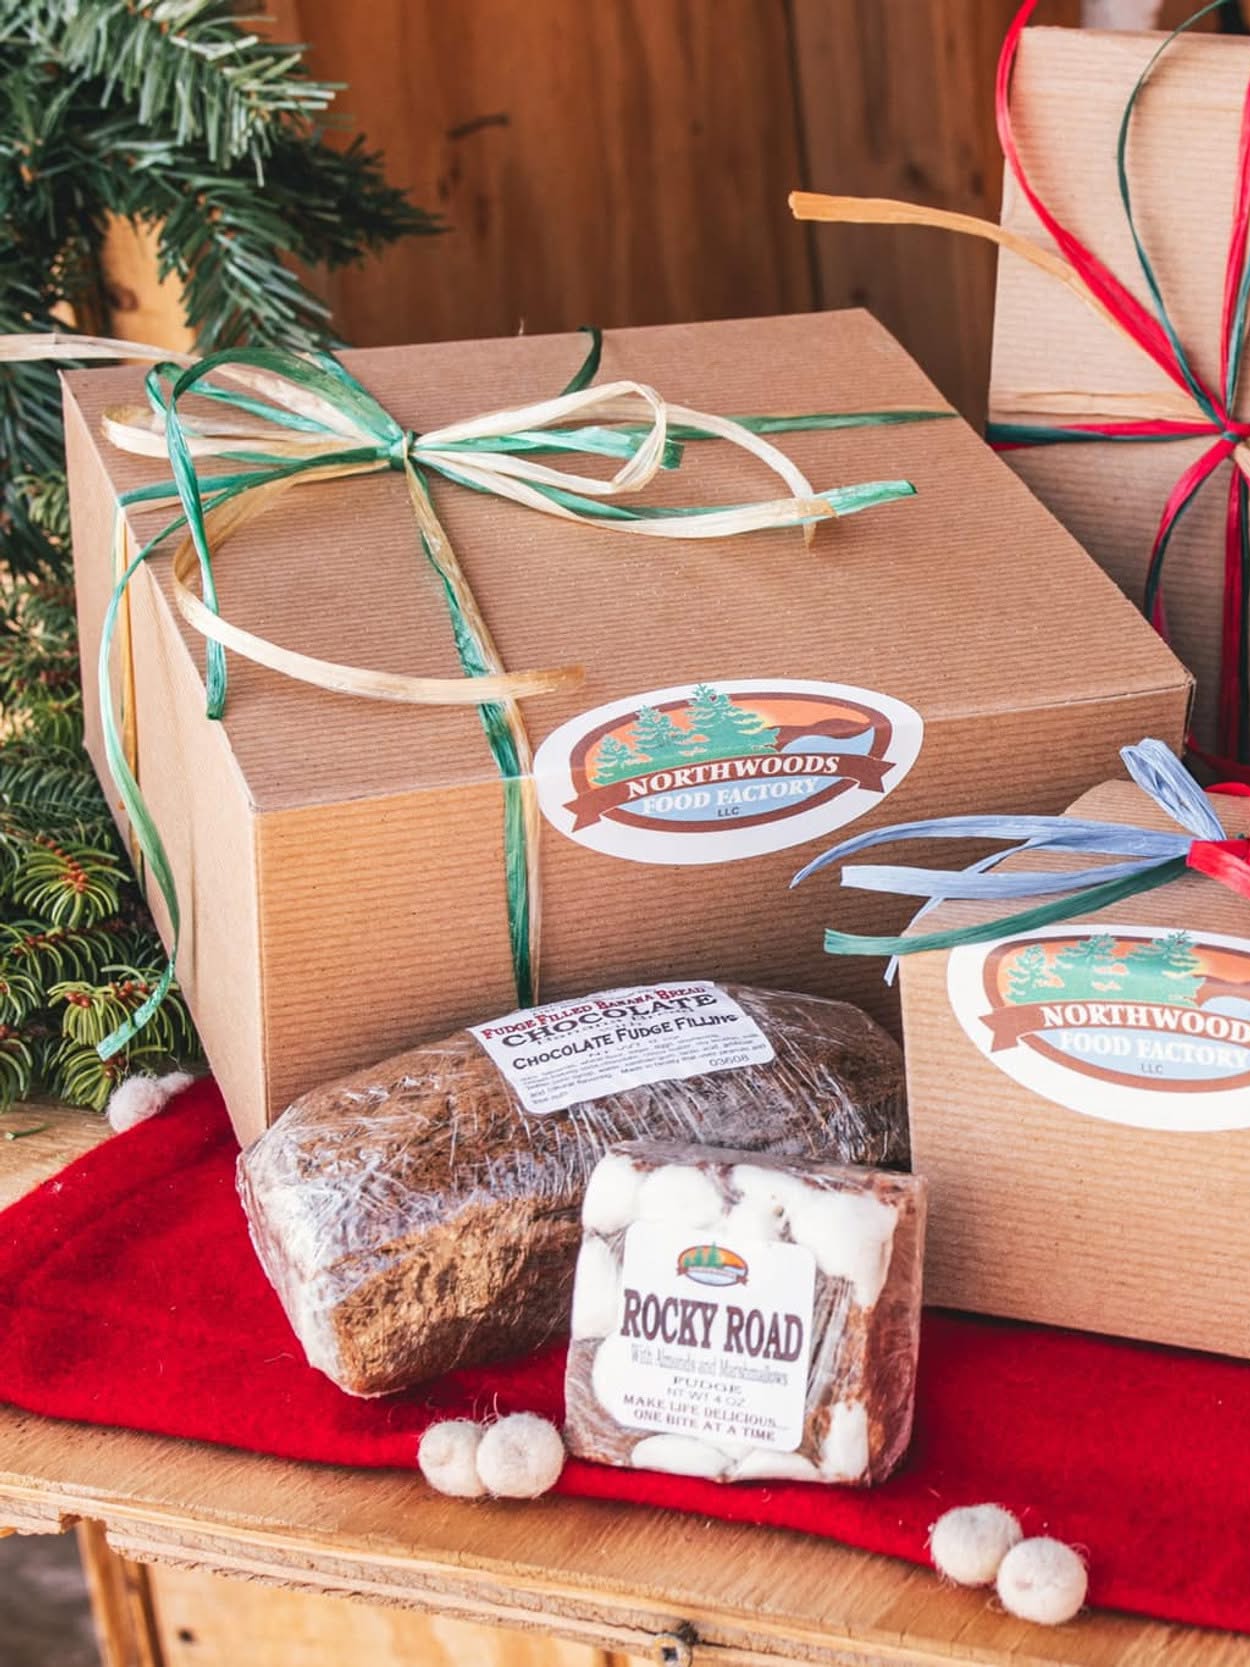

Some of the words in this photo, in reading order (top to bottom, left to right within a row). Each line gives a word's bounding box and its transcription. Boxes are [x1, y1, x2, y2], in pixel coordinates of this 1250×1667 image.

[626, 756, 840, 799] NORTHWOODS
[642, 790, 711, 815] FOOD
[717, 778, 820, 807] FACTORY
[717, 806, 739, 818] LLC
[481, 1019, 536, 1040] FUDGE
[535, 1003, 593, 1025] FILLED
[655, 986, 706, 1001] BREAD
[502, 994, 717, 1047] CHOCOLATE
[513, 1033, 615, 1070] CHOCOLATE
[615, 1021, 673, 1042] FUDGE
[674, 1014, 739, 1031] FILLING
[1059, 1031, 1131, 1057] FOOD
[1136, 1038, 1250, 1069] FACTORY
[1140, 1063, 1164, 1075] LLC
[620, 1289, 718, 1349] ROCKY
[723, 1306, 804, 1362] ROAD
[673, 1376, 742, 1394] FUDGE
[623, 1394, 666, 1409] MAKE
[670, 1400, 699, 1415] LIFE
[634, 1408, 662, 1423] ONE
[666, 1414, 697, 1428] BITE
[703, 1420, 724, 1433] AT
[726, 1425, 737, 1435] A
[743, 1427, 776, 1441] TIME
